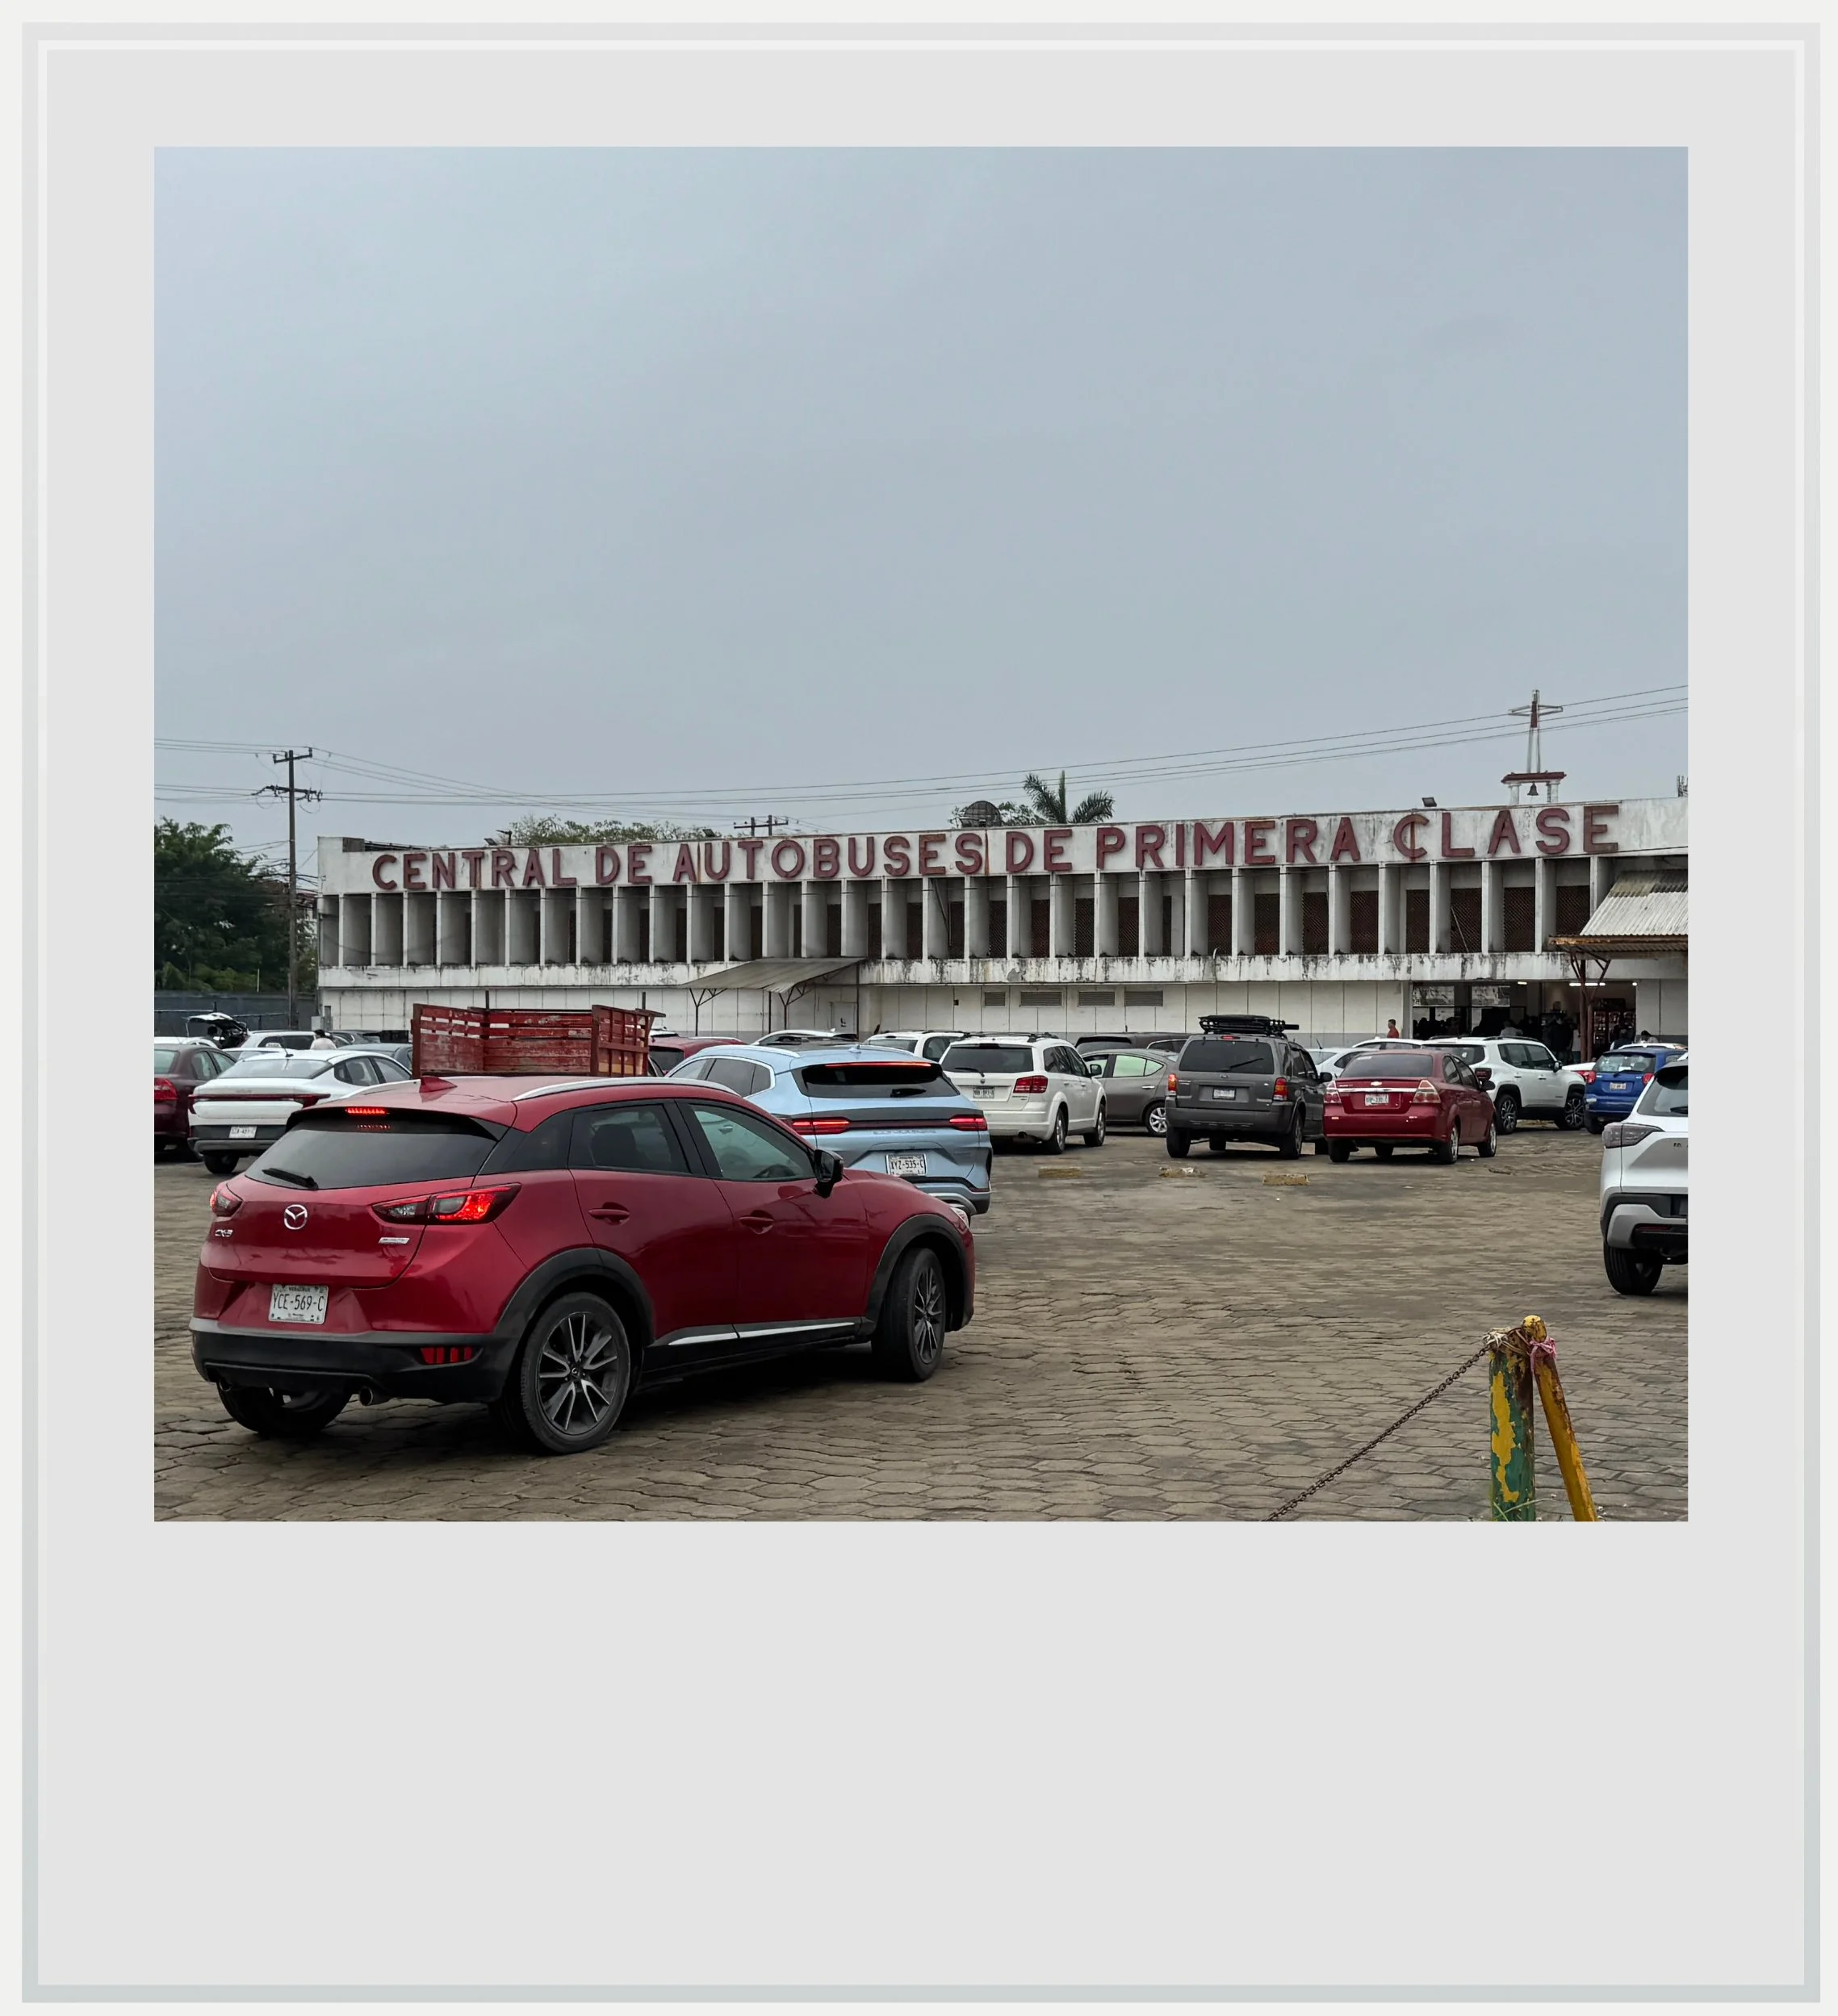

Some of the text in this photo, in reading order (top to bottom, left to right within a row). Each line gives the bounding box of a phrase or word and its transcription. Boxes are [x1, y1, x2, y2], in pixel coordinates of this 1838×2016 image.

[372, 805, 1619, 889] CENTRAL DE AUTOBUSES DE PRIMERA CLASE
[273, 1292, 324, 1311] YCE-569-C
